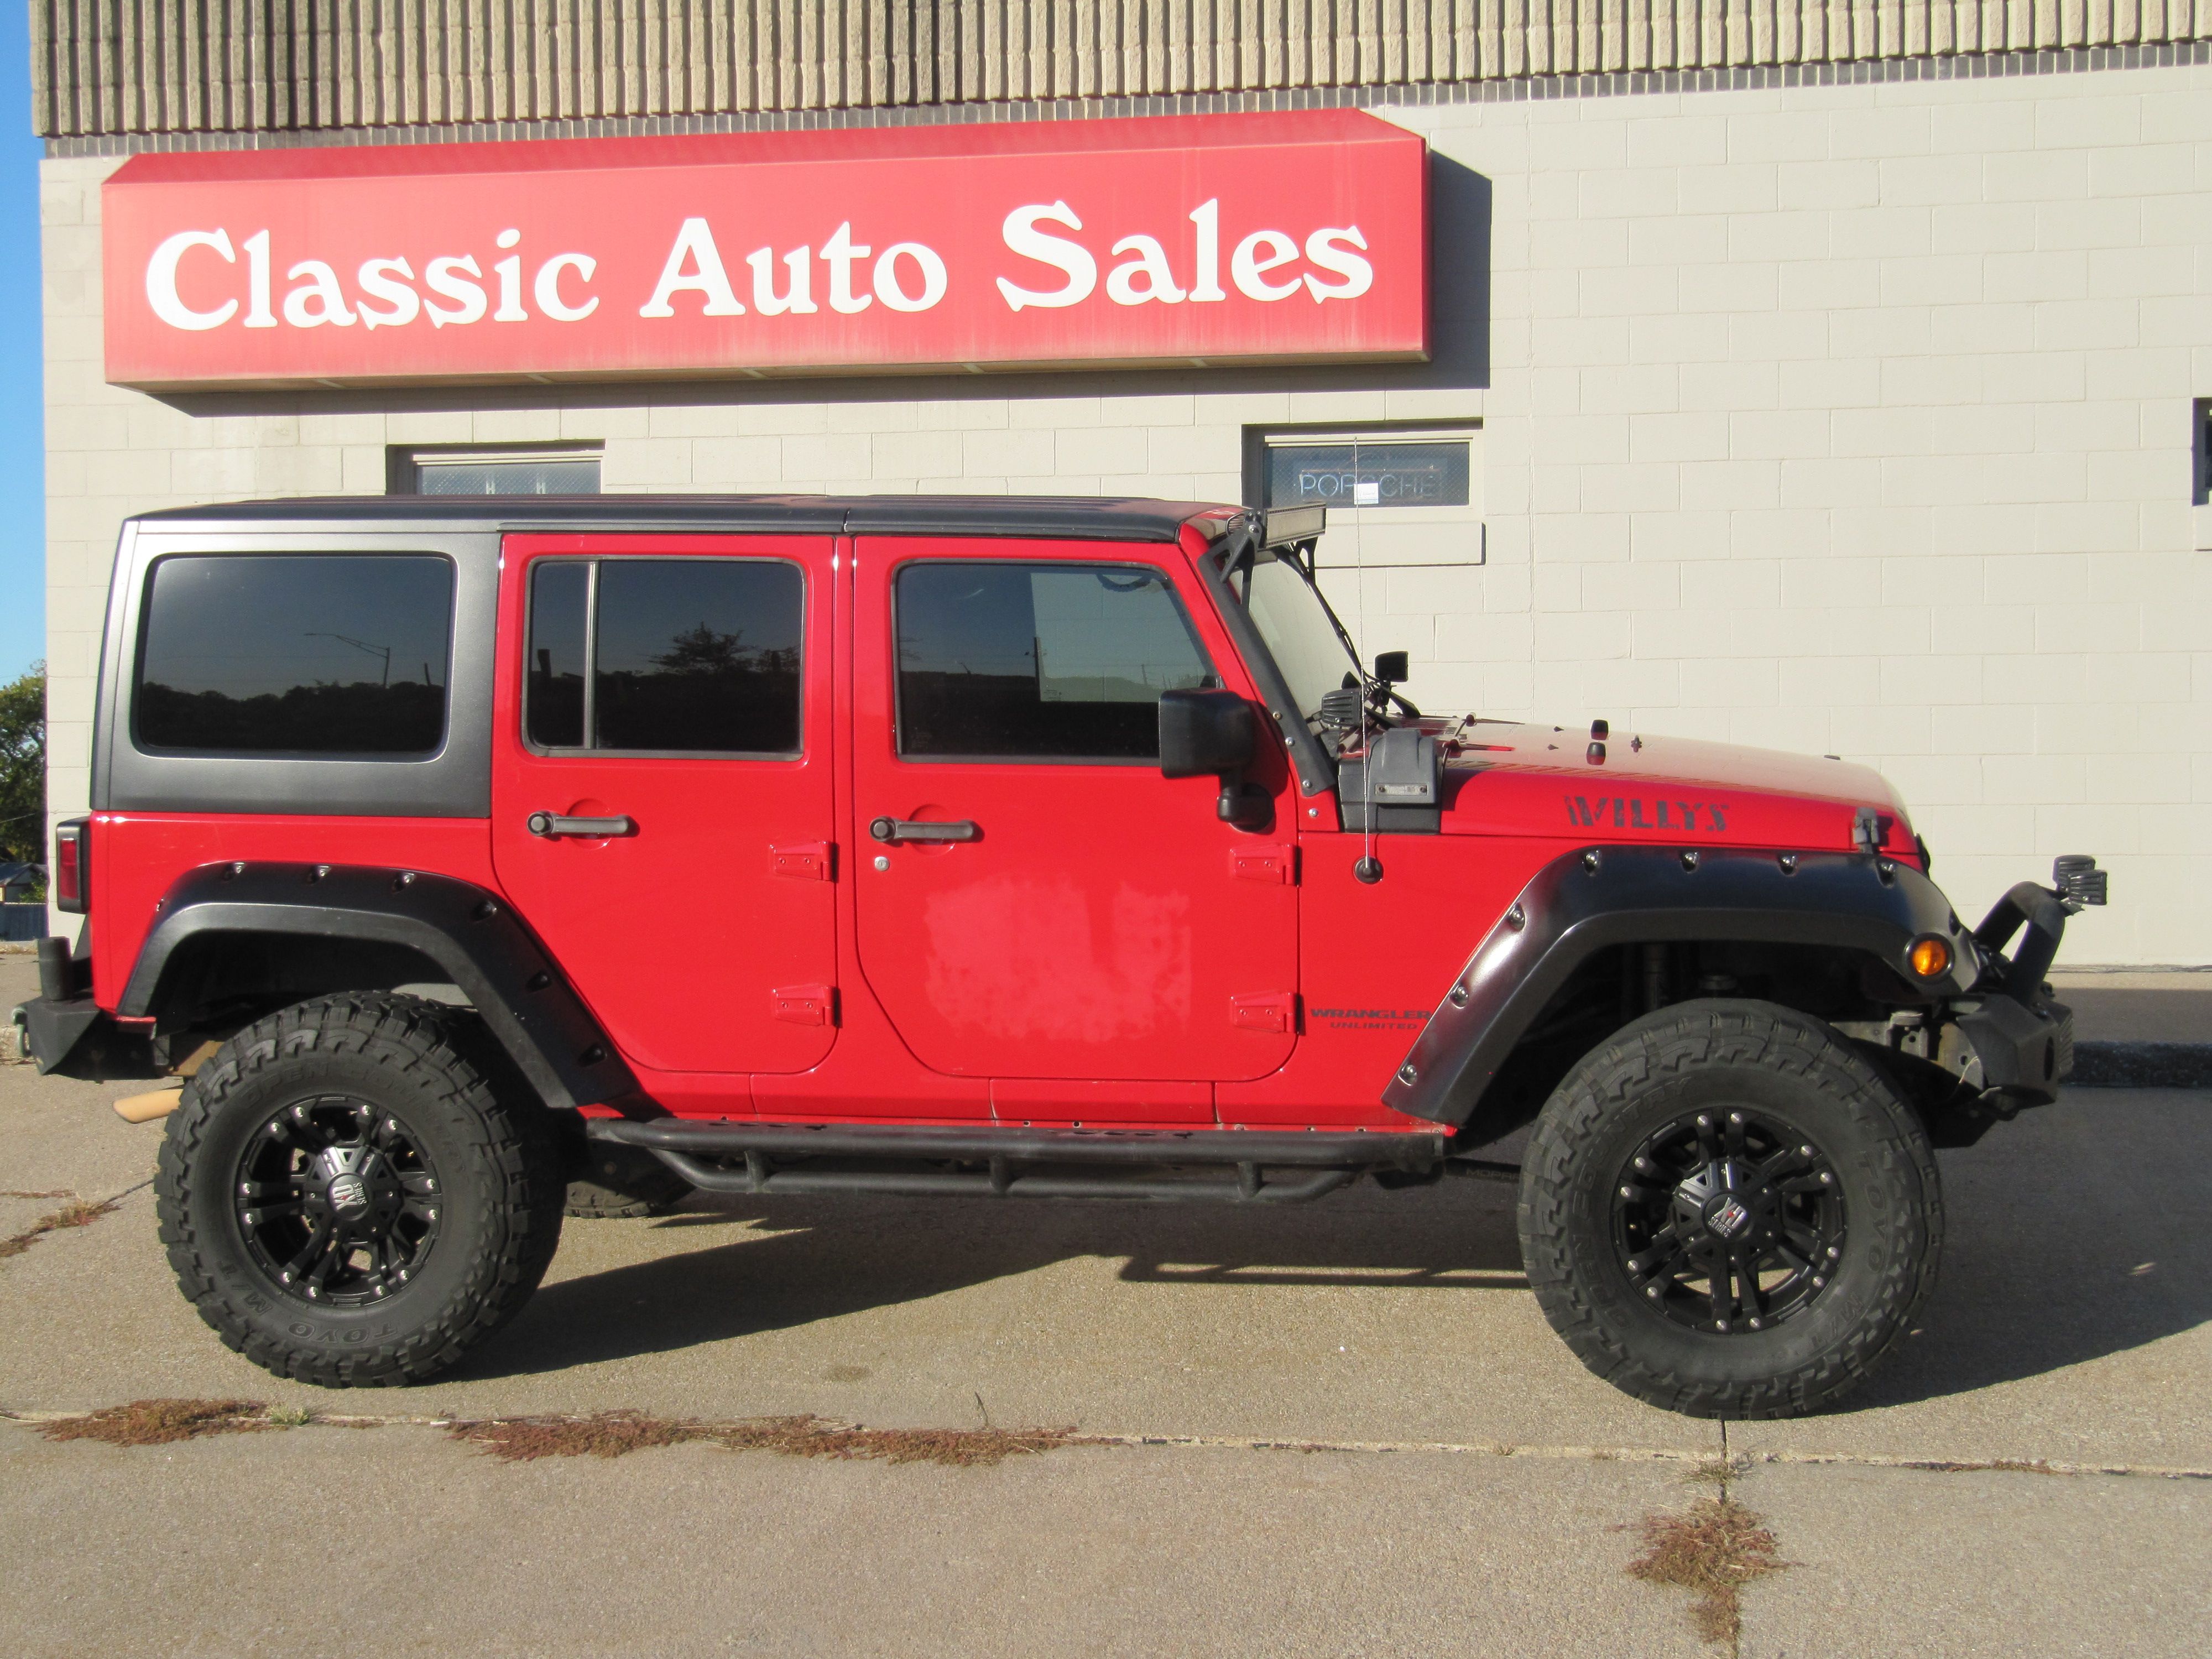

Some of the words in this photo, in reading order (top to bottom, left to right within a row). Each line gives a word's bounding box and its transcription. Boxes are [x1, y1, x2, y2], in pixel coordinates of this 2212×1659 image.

[144, 226, 599, 332] Classic
[639, 216, 948, 319] Auto
[995, 197, 1374, 312] Sales
[1564, 796, 1729, 832] WILLYS
[1311, 1009, 1432, 1020] WRANGLER
[1330, 1021, 1417, 1030] UNLIMITED
[353, 1182, 367, 1205] SERIES
[288, 1320, 399, 1345] TOYO
